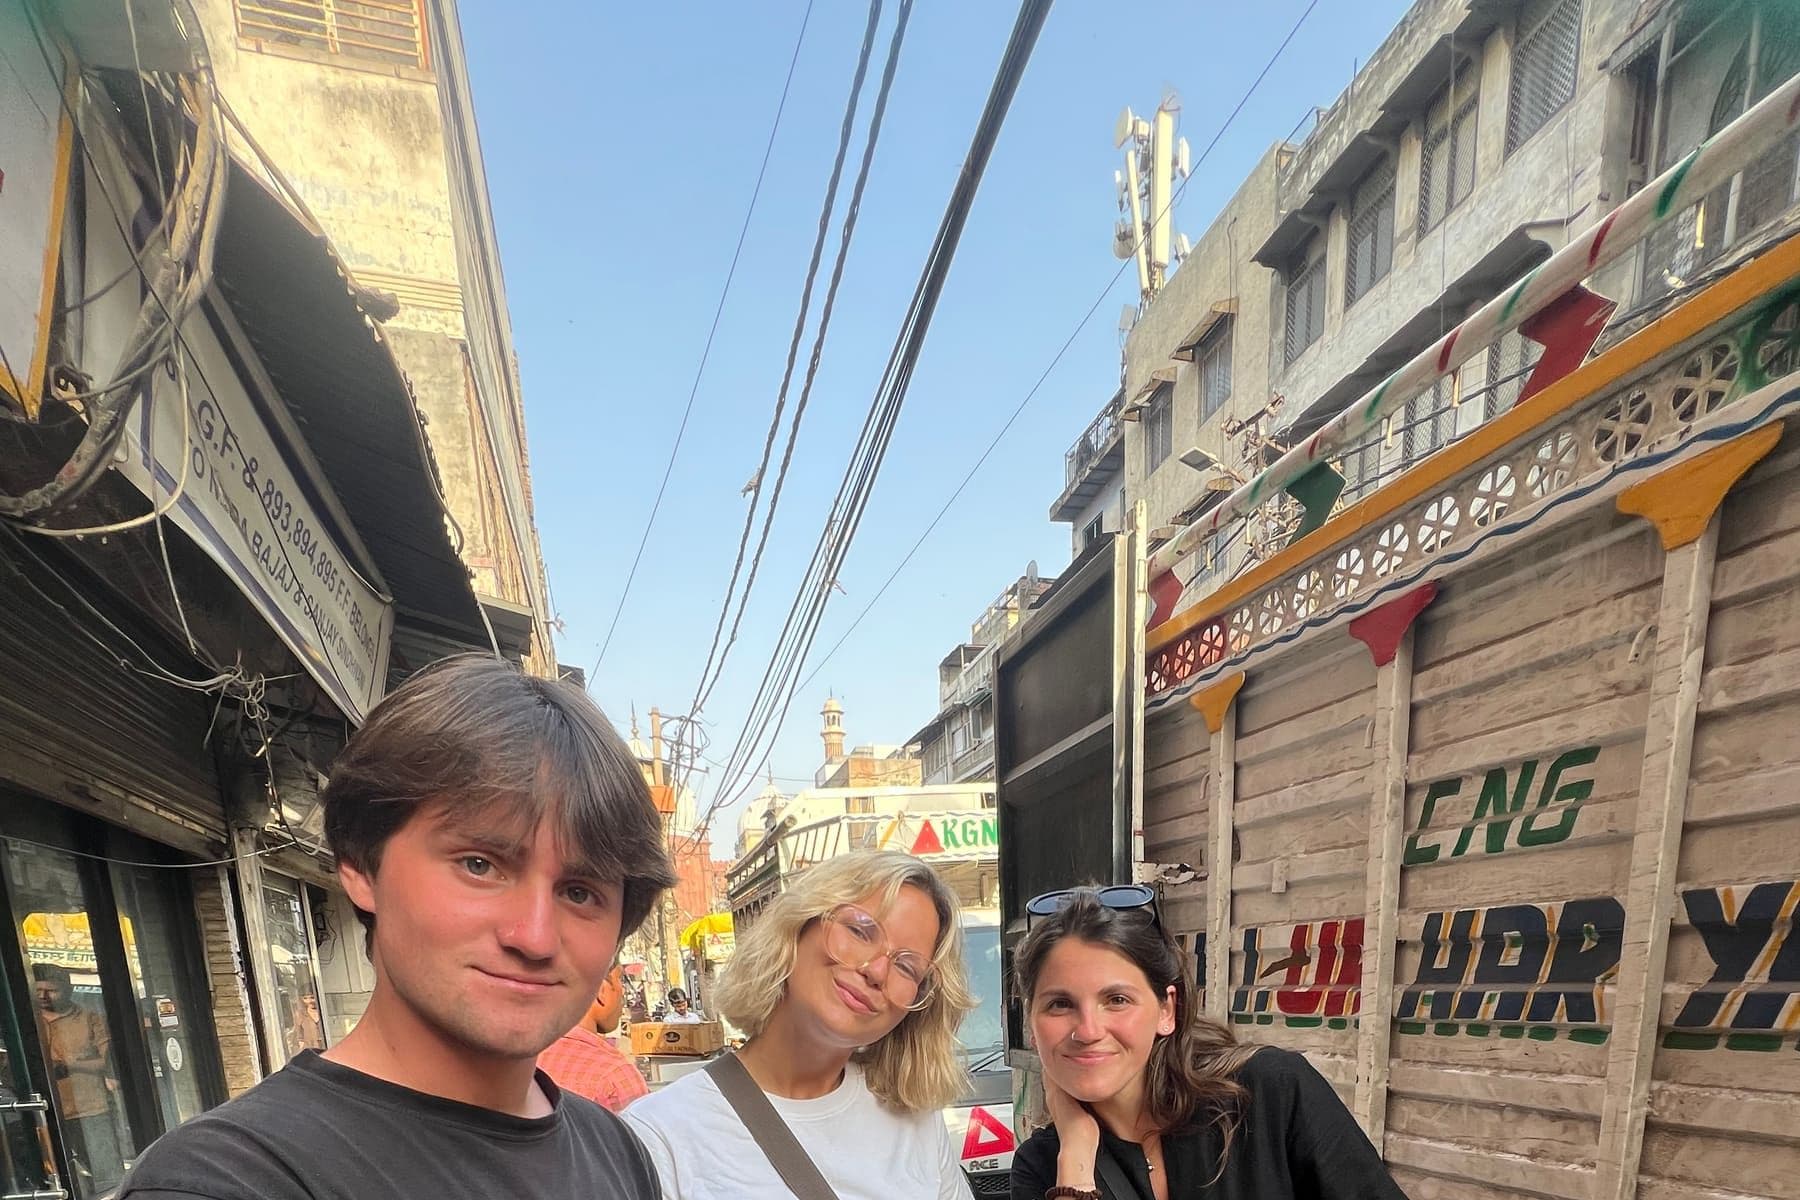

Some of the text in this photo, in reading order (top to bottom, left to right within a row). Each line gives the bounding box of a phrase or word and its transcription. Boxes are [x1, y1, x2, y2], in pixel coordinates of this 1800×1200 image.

[243, 456, 258, 493] &
[252, 530, 297, 593] BAJAJ
[304, 594, 339, 648] SANJAY
[1403, 746, 1601, 866] CNG
[941, 818, 998, 849] KGN
[969, 1158, 999, 1171] ACE
